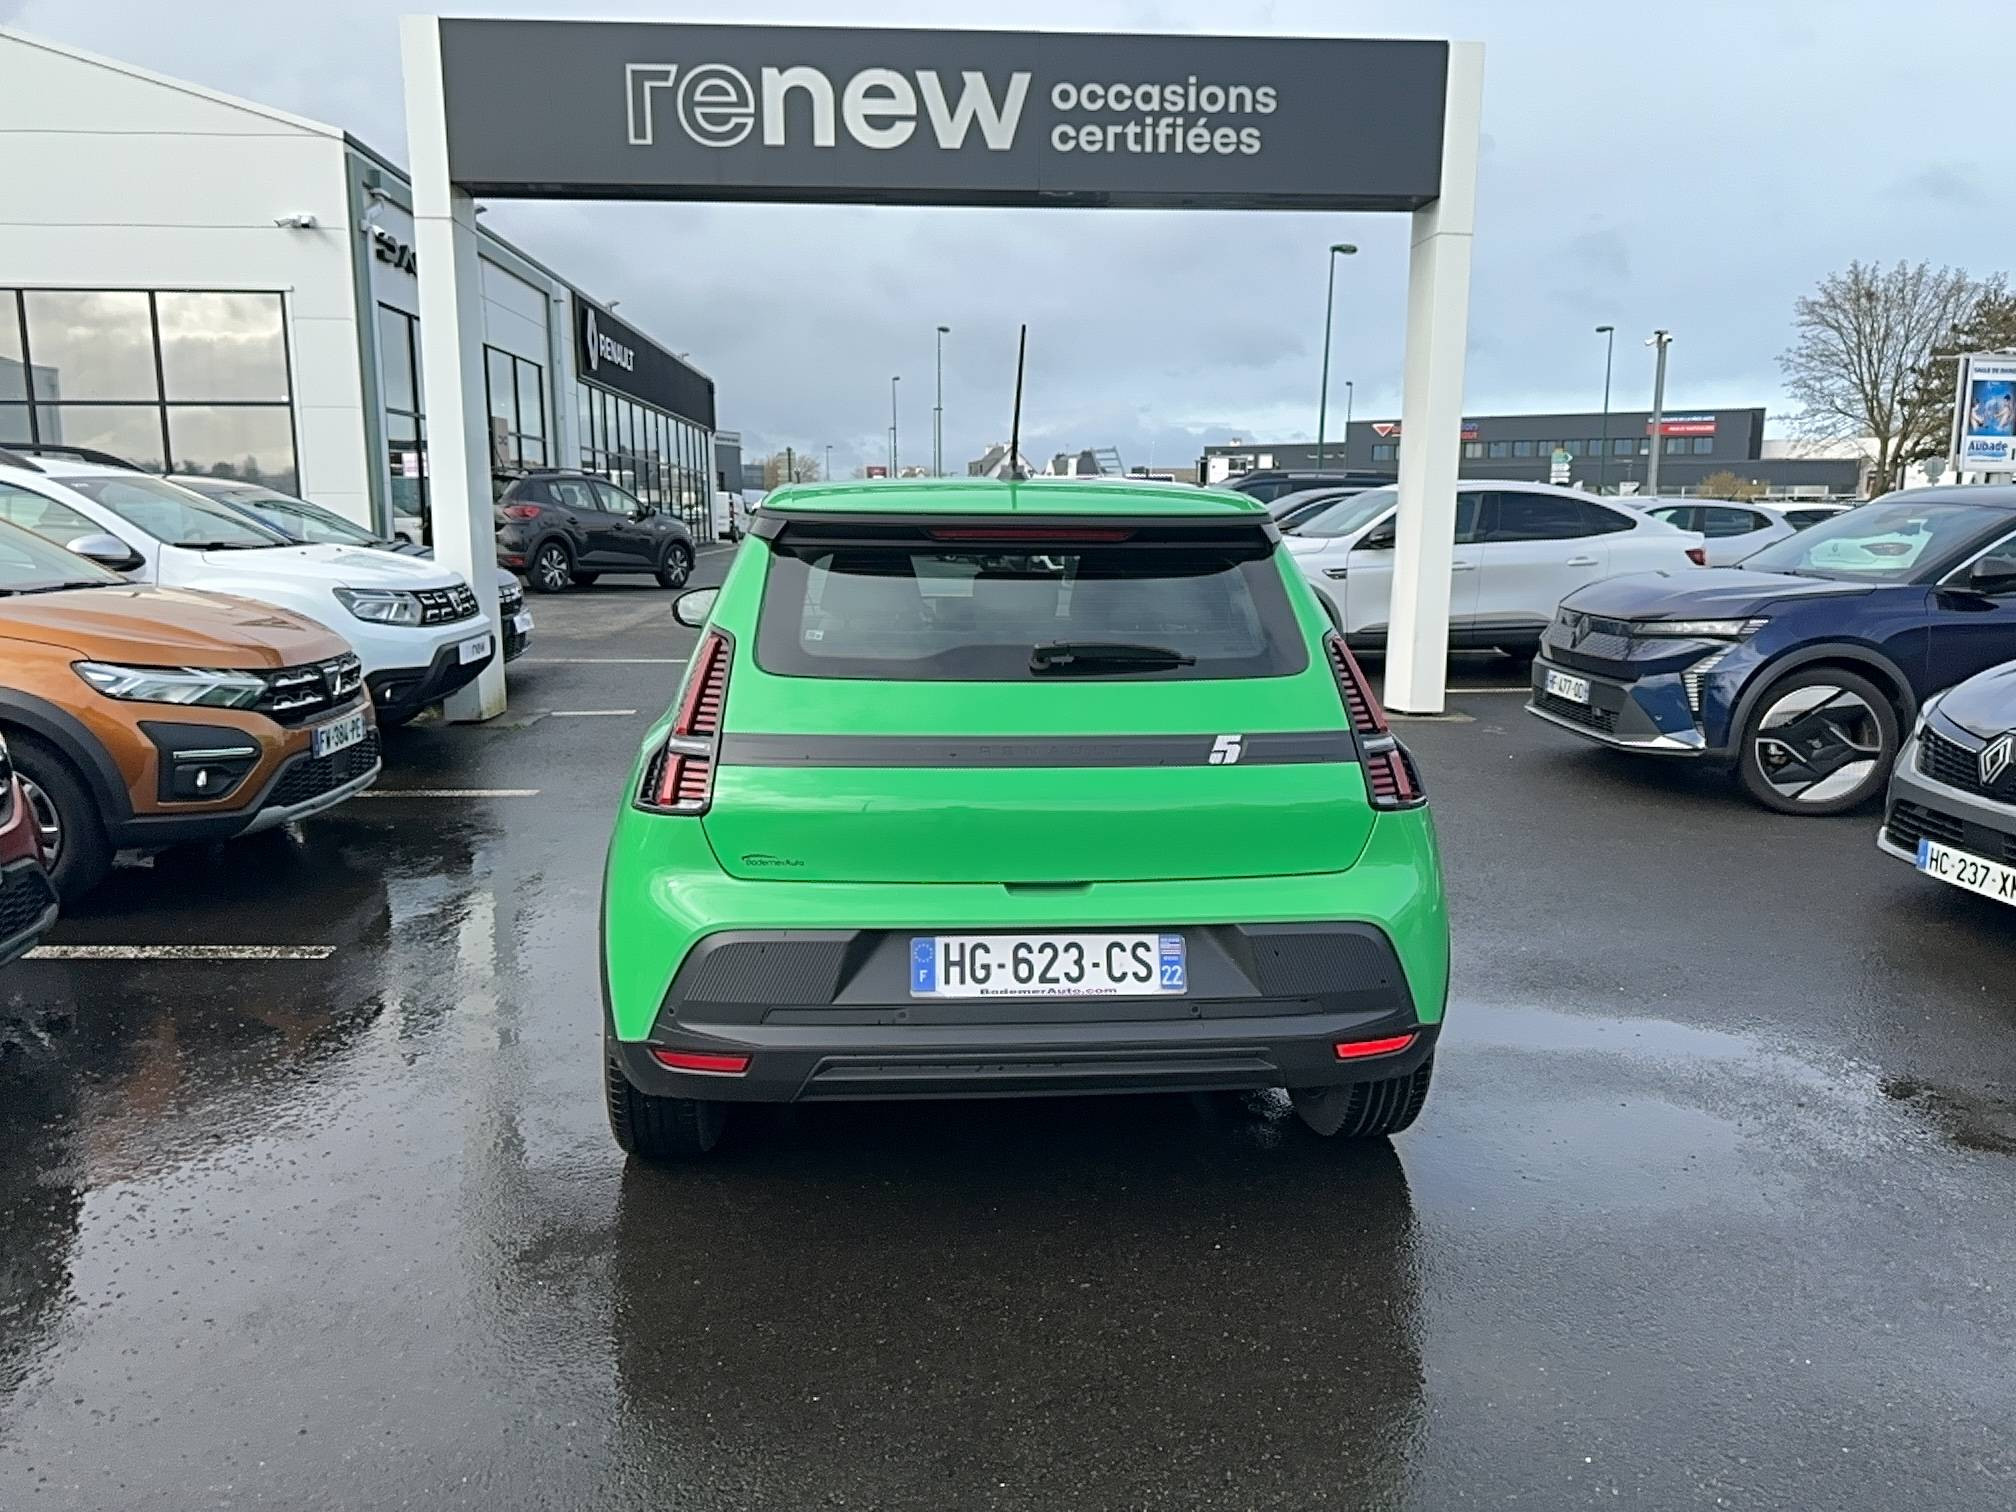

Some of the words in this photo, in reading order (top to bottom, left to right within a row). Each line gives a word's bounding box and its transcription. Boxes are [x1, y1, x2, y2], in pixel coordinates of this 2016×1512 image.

[625, 63, 1032, 150] renew
[1051, 75, 1278, 113] occasions
[1051, 116, 1261, 154] certifiées
[599, 333, 634, 371] RENAULT
[1209, 735, 1242, 765] 5
[919, 970, 928, 983] F
[943, 940, 1153, 985] HG-623-CS
[1161, 965, 1183, 985] 22
